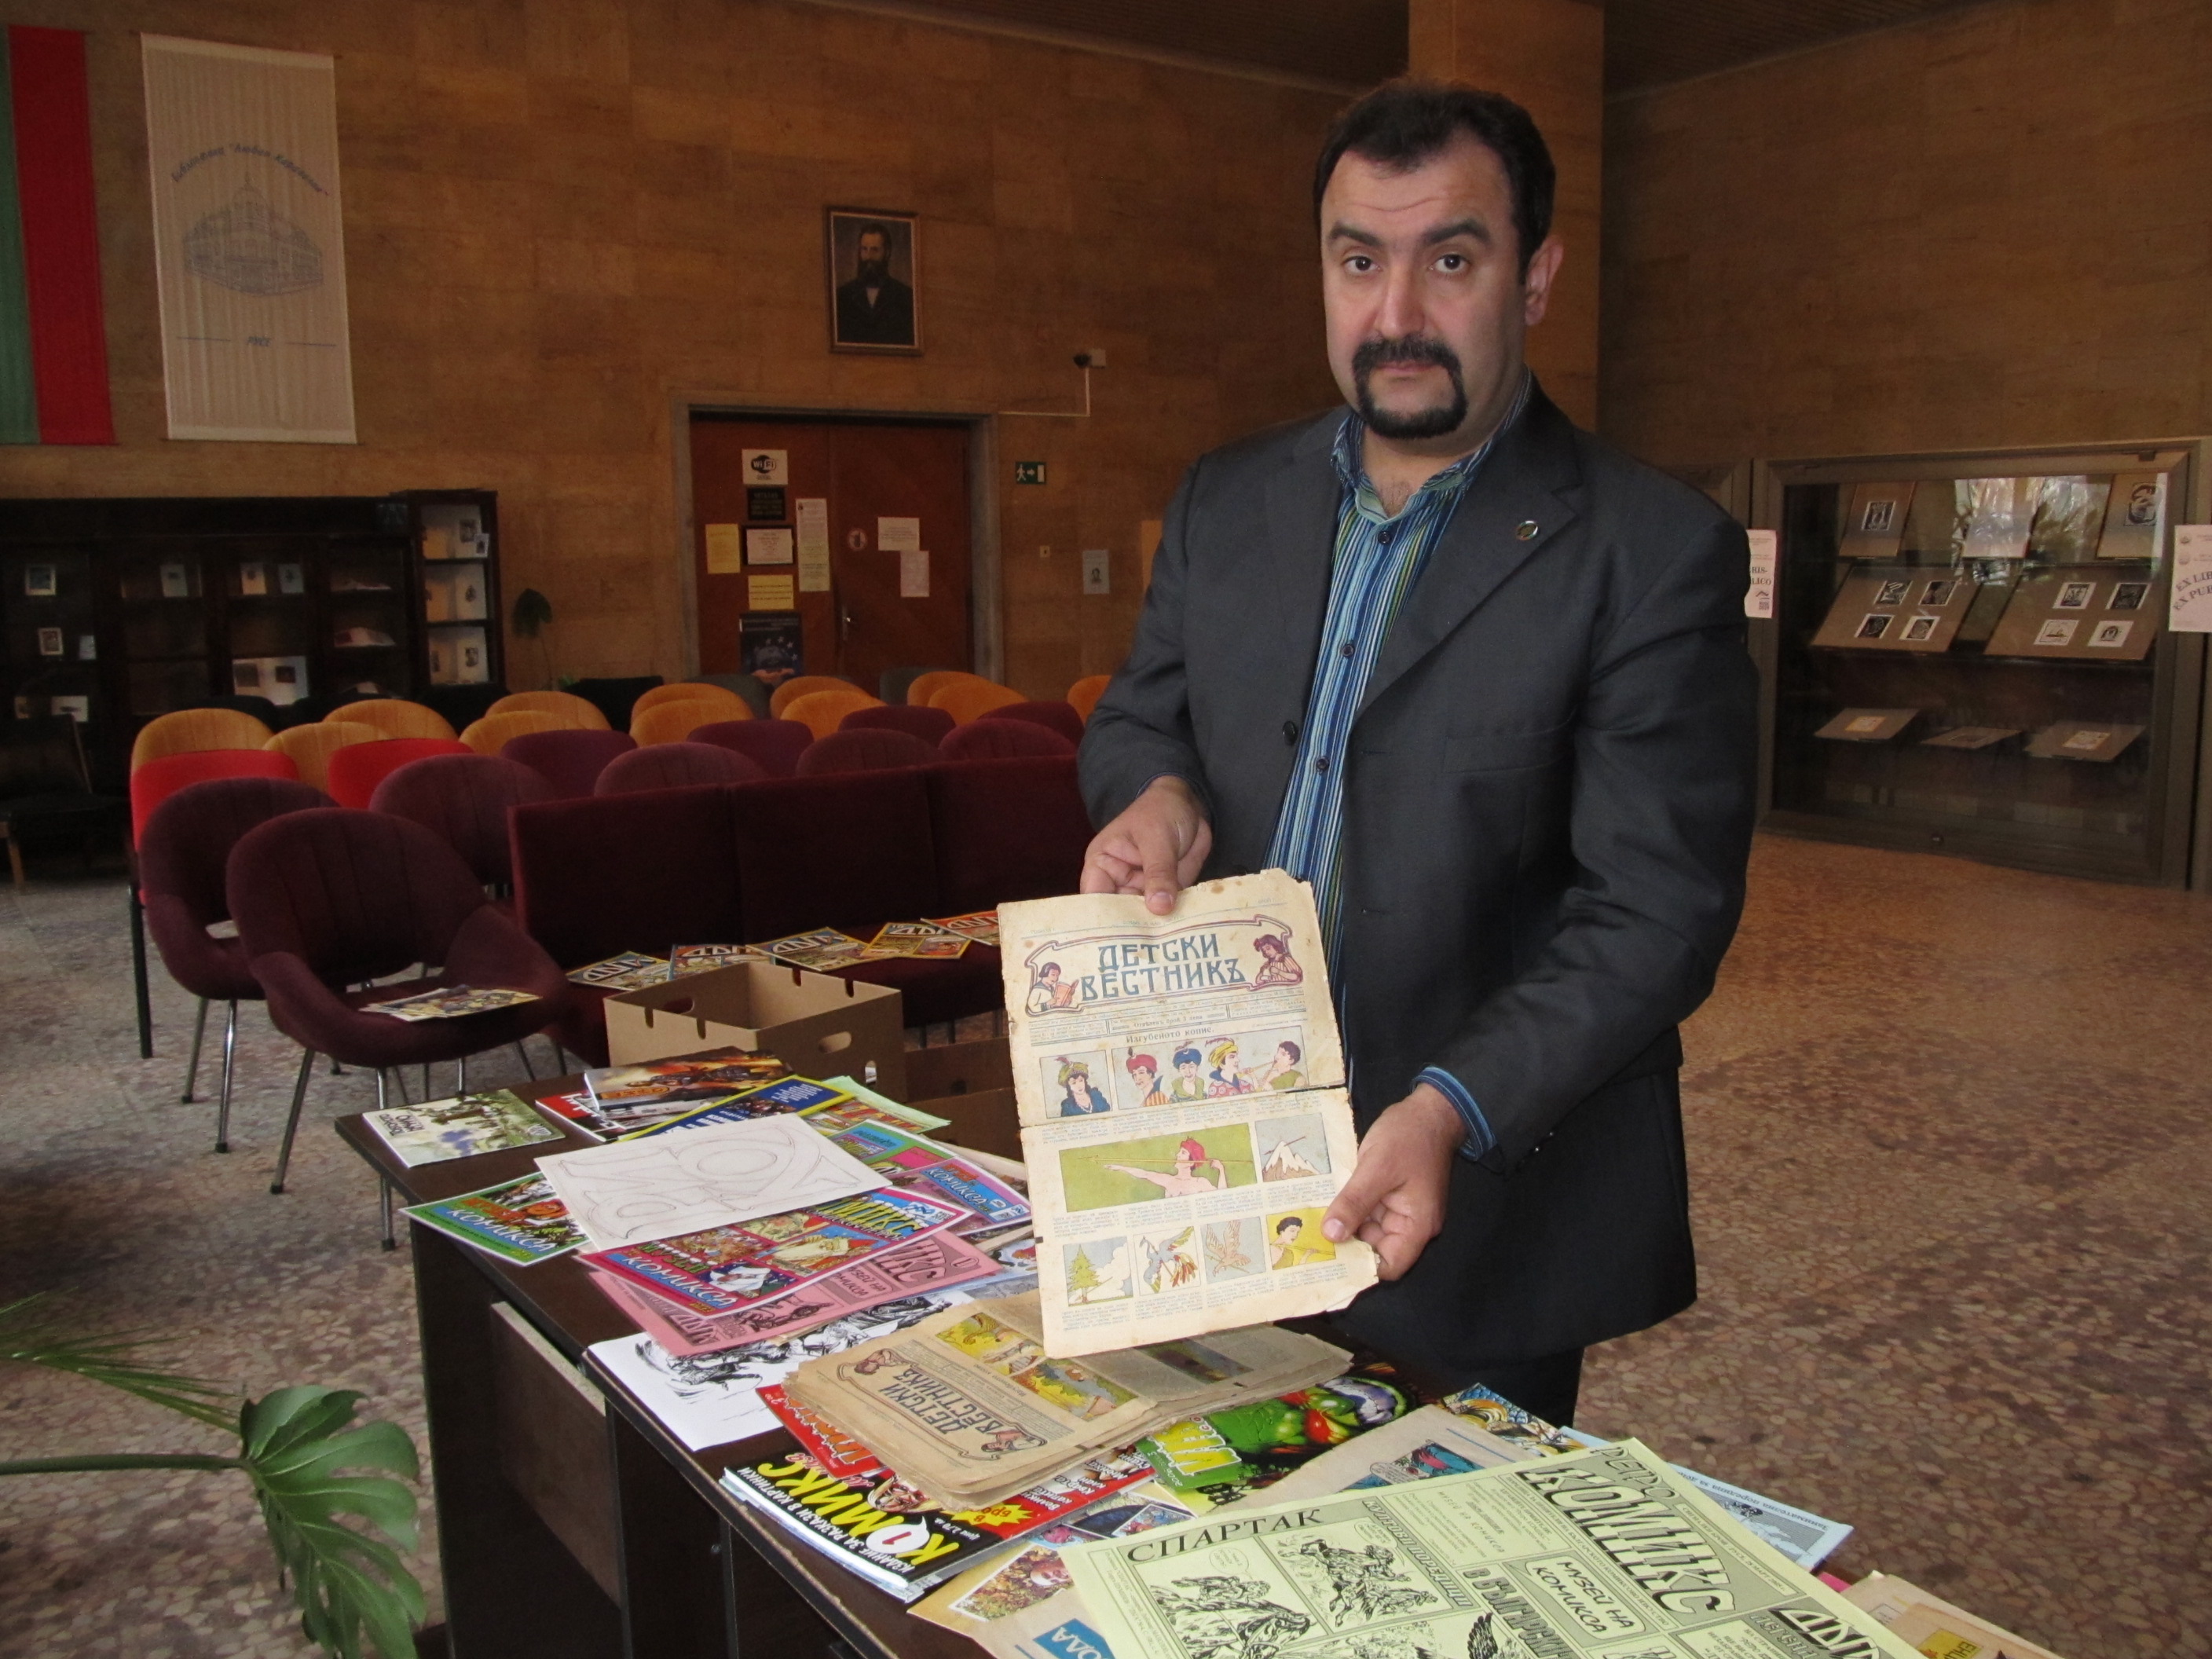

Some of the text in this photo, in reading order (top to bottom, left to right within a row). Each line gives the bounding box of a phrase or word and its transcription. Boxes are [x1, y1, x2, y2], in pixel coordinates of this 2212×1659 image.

[1750, 577, 1771, 586] LICO
[1098, 933, 1220, 972] ДЕТСКИ
[1081, 958, 1246, 1002] ВЕСТНИКЪ
[1126, 1027, 1214, 1044] Изгубеното копие.
[927, 1167, 989, 1207] КОМИКСА
[445, 1206, 557, 1254] КОМИКСА
[621, 1254, 737, 1308] КОМИКСА
[877, 1381, 968, 1436] ДЕТСКИ
[892, 1365, 1002, 1437] ВЕСТНИКЪ
[1590, 1447, 1681, 1499] РЕТРО
[736, 1465, 915, 1574] ИЗДАНИЕ ЗА РАЗКАЗИ В КАРТИНКИ
[1127, 1508, 1322, 1562] СПАРТАК
[1515, 1468, 1736, 1613] КОМИКС
[1361, 1501, 1417, 1545] КУЛТОВИ
[1405, 1547, 1474, 1606] ПОРЕДИЦИ
[1532, 1566, 1608, 1632] КОМИКСА
[1557, 1561, 1635, 1629] МУЗЕЙ НА
